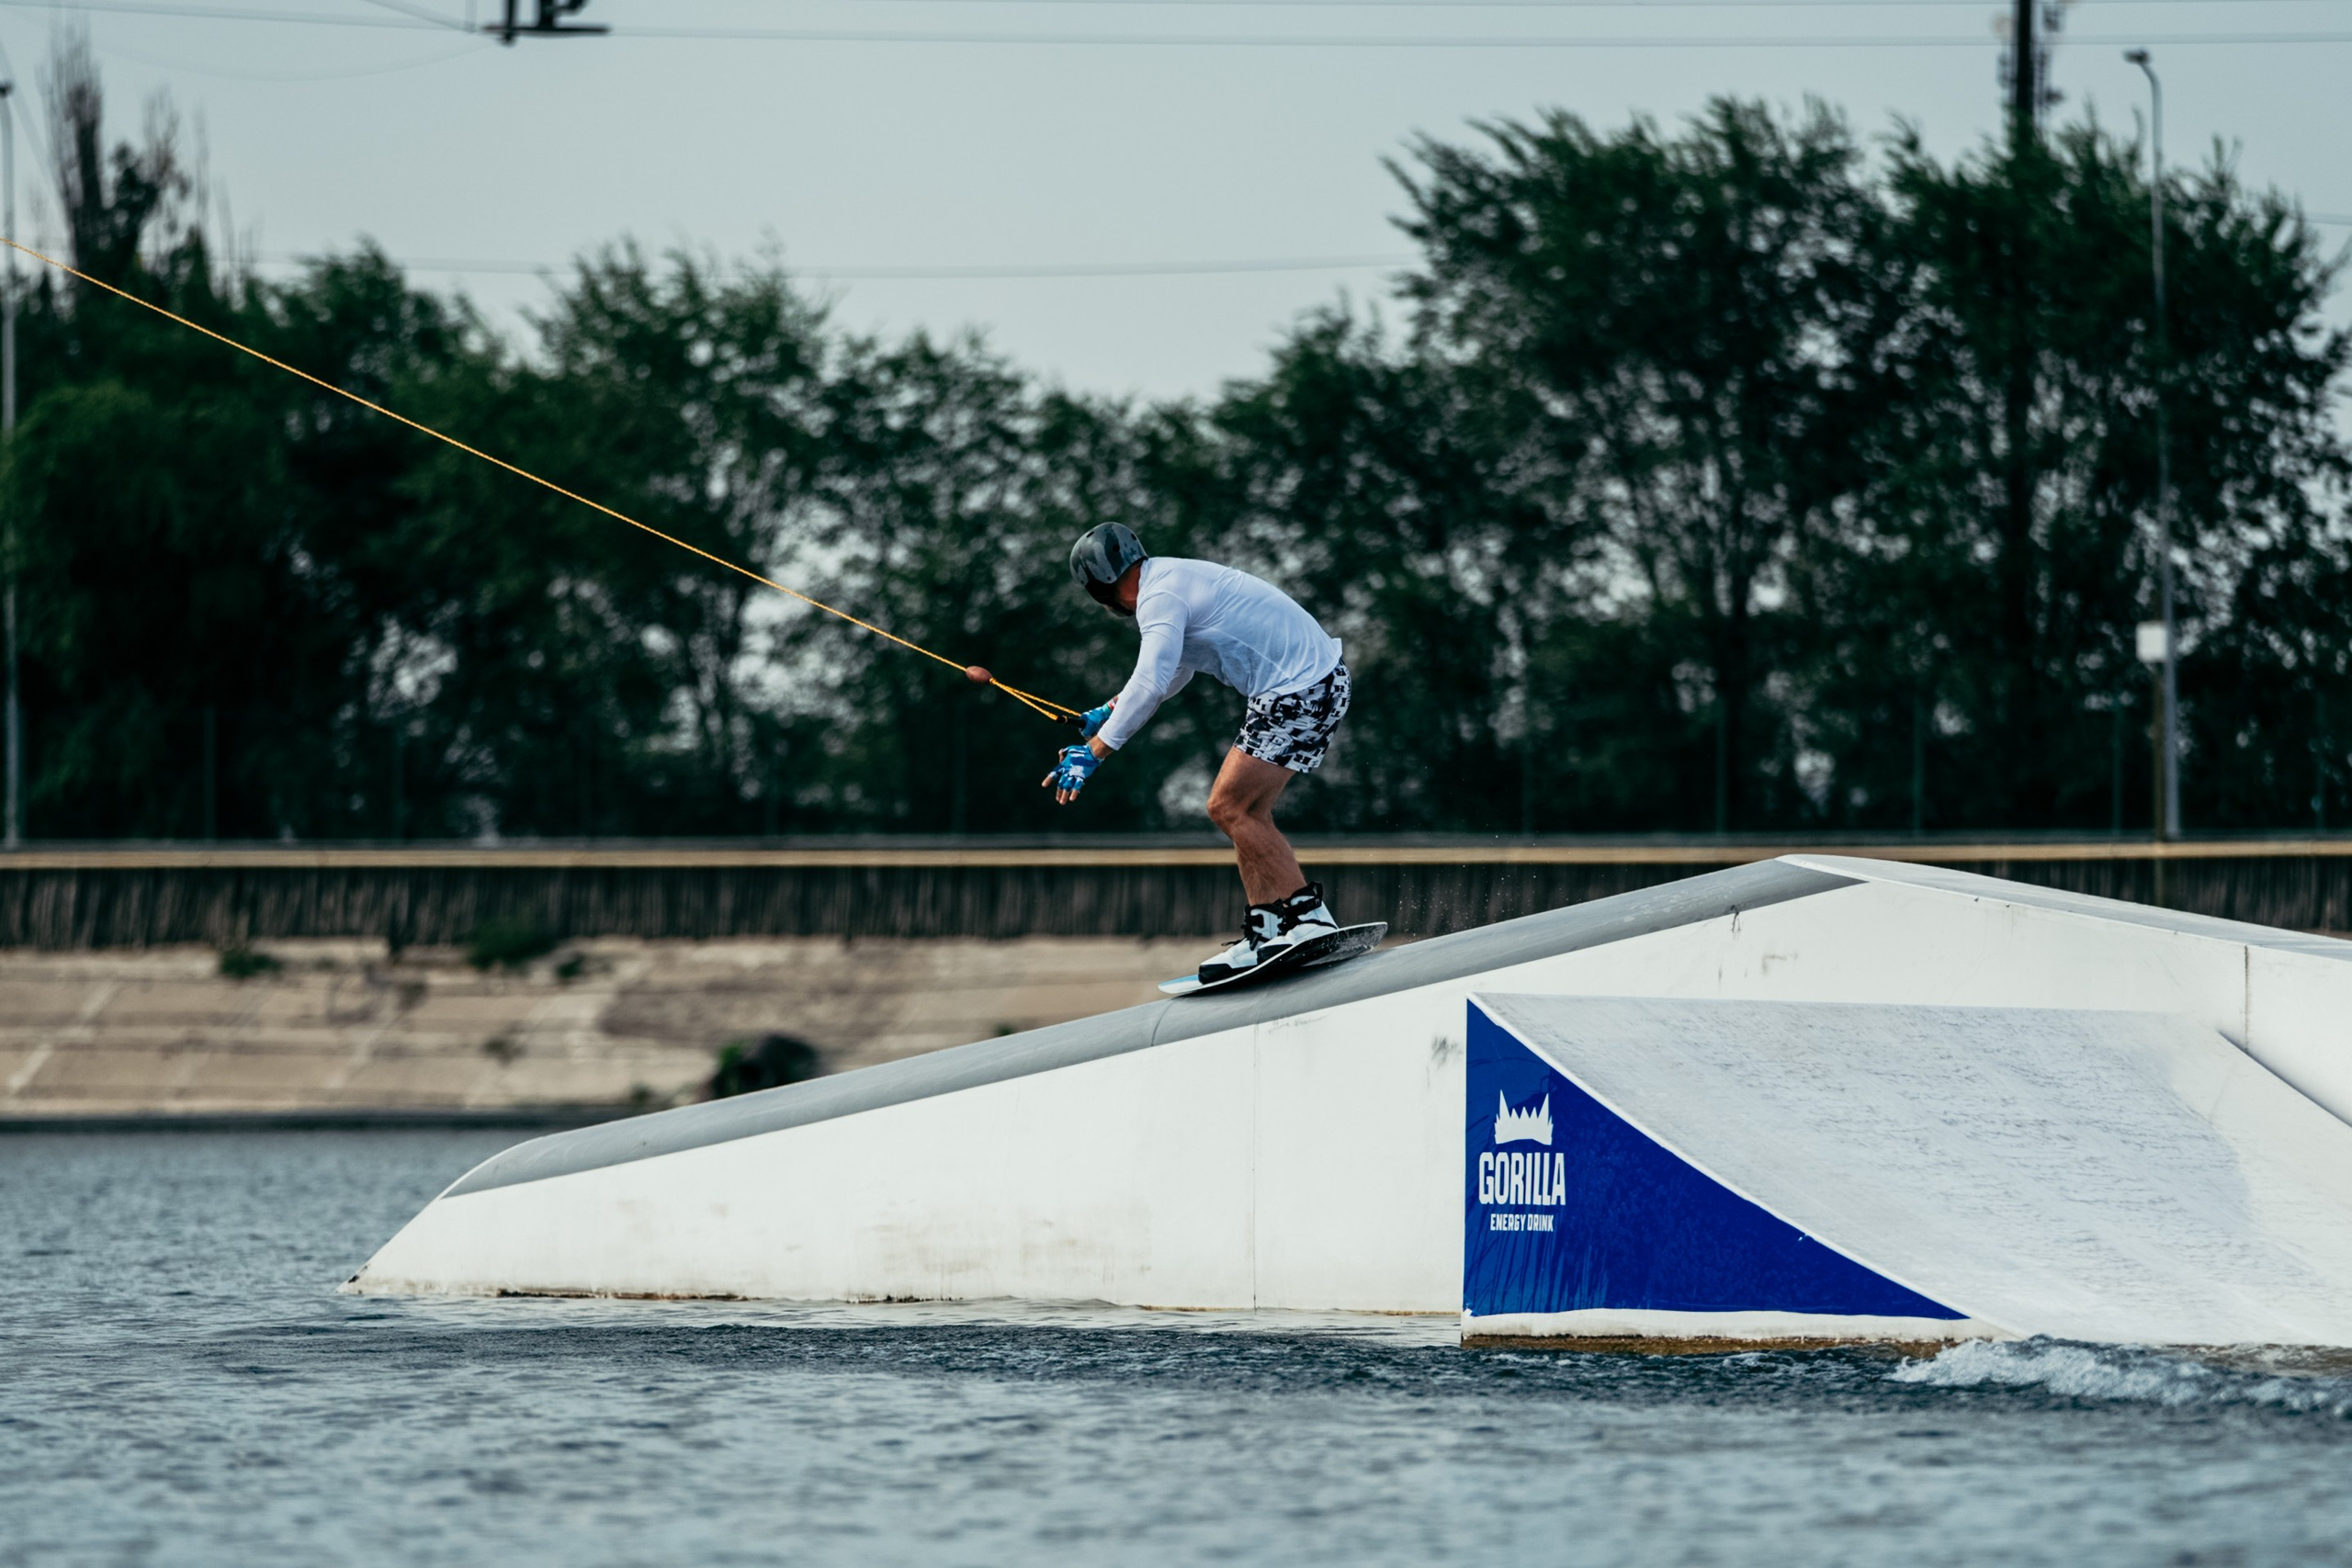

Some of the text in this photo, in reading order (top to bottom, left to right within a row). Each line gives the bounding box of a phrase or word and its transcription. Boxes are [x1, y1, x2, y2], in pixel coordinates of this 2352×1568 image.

[1478, 1151, 1566, 1206] GORILLA
[1490, 1213, 1555, 1232] ENERGY DRINK
